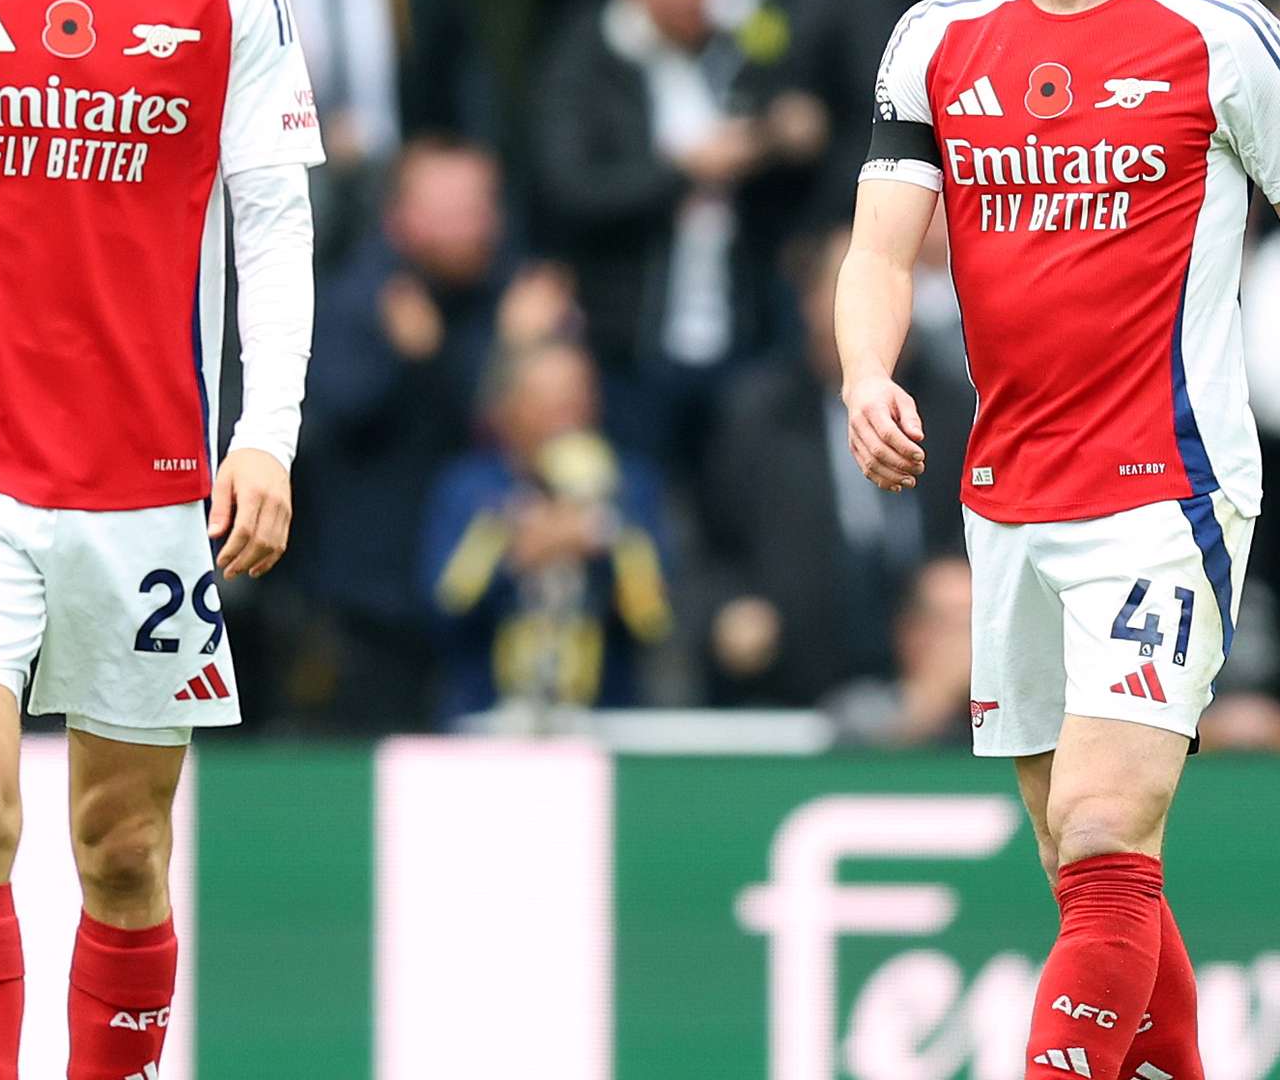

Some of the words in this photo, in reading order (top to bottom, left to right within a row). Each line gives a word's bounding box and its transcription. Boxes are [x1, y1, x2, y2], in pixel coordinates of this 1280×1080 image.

[281, 111, 319, 131] RWA
[46, 137, 148, 182] BETTER
[945, 134, 1166, 186] Emirates
[981, 193, 1021, 233] FLY
[1028, 191, 1130, 232] BETTER
[1119, 463, 1166, 476] HEAT.RDY
[133, 568, 224, 655] 29
[1110, 578, 1195, 667] 41
[109, 1006, 170, 1032] AFC
[1051, 994, 1118, 1029] AFC
